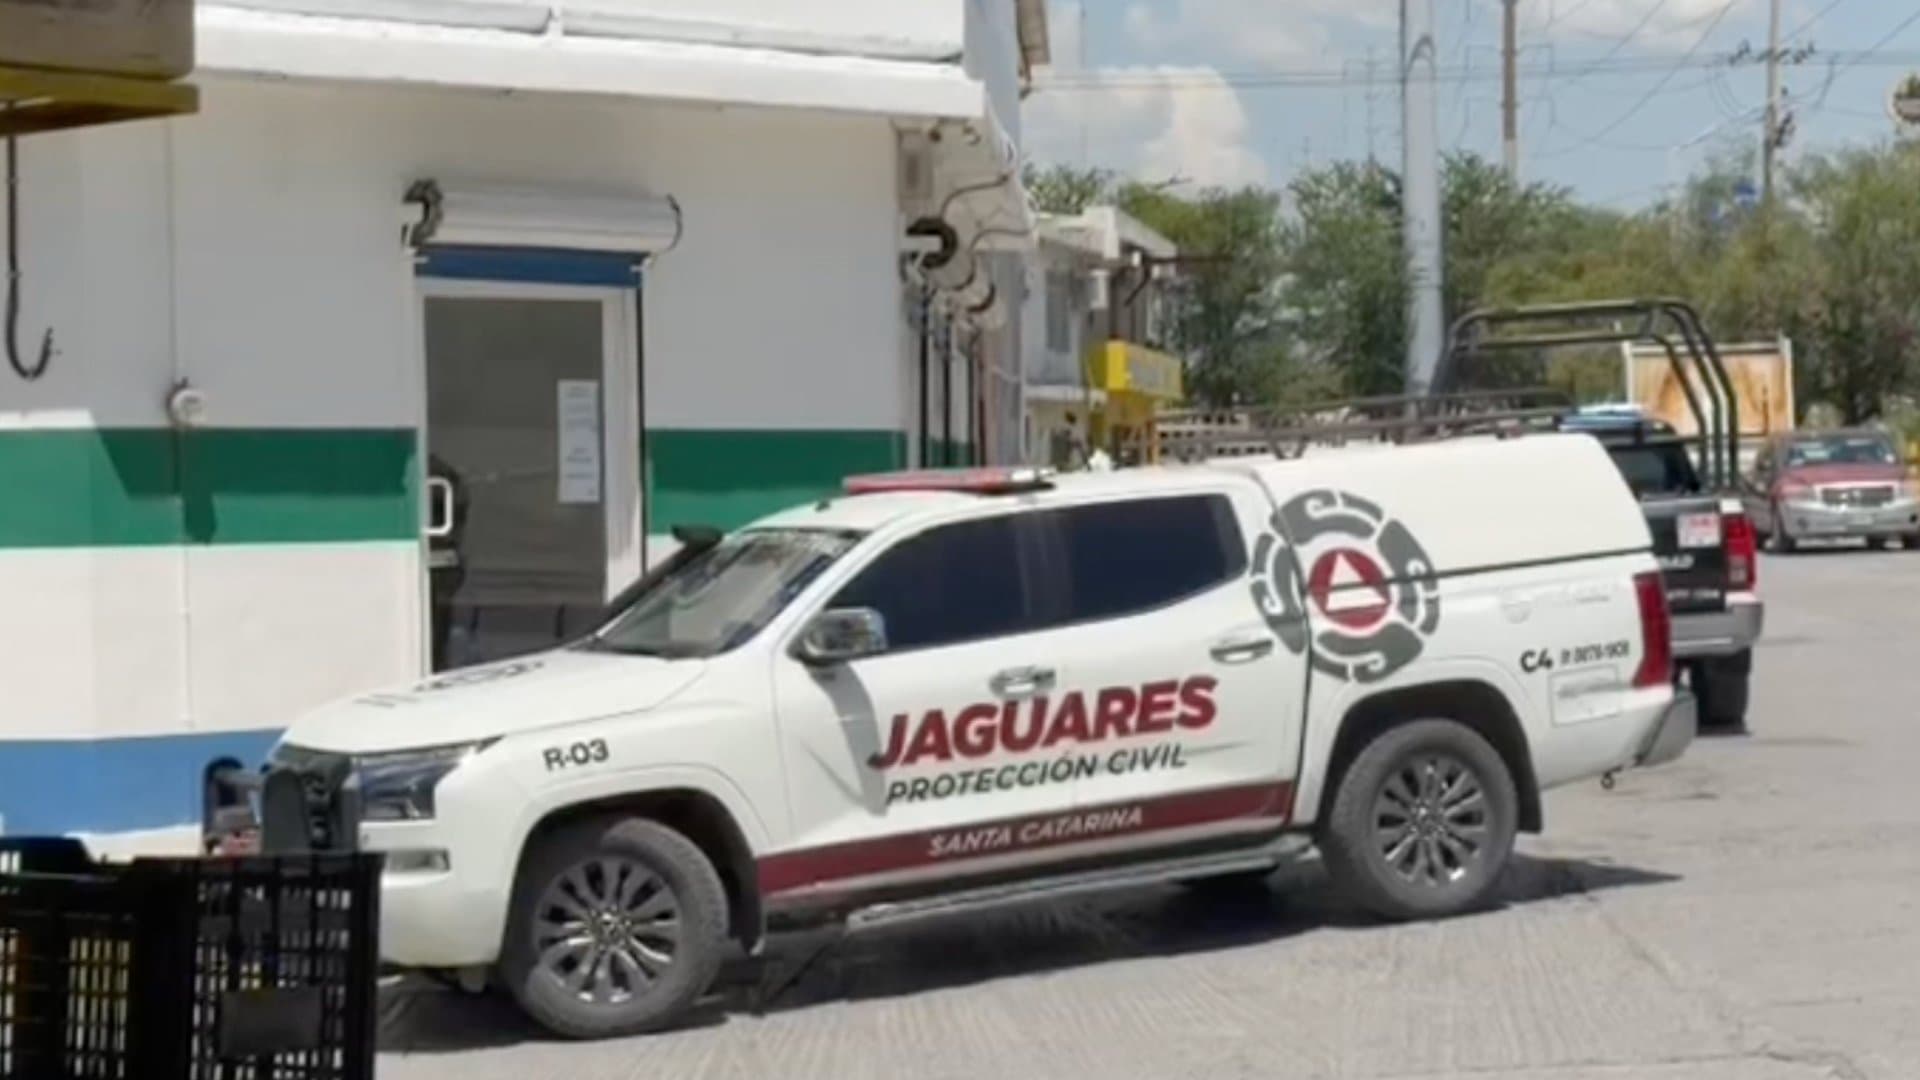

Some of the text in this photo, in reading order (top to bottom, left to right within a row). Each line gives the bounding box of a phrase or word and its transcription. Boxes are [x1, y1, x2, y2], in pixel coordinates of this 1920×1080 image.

[1520, 648, 1553, 673] C4
[868, 675, 1218, 770] JAGUARES
[542, 737, 609, 771] R-03
[886, 743, 1187, 805] PROTECCIÓN CIVIL
[928, 807, 1143, 857] SANTA CATARINA
